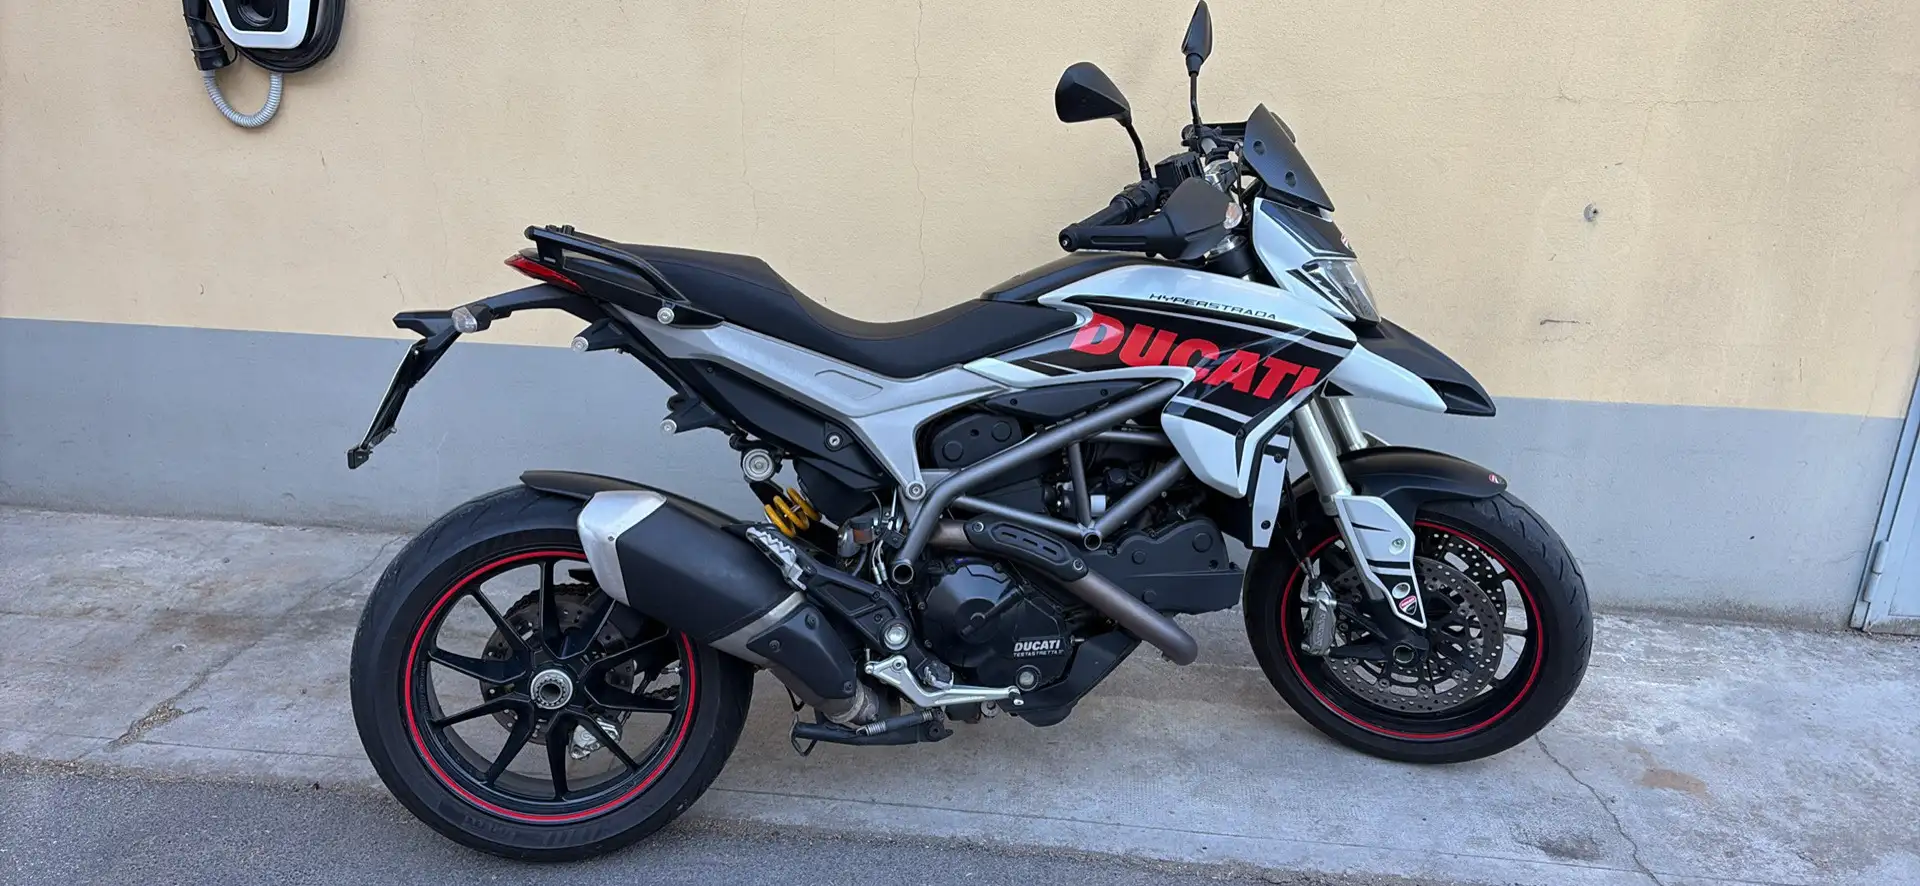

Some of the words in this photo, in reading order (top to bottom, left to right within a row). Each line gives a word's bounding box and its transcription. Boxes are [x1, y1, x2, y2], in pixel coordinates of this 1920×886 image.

[1149, 293, 1276, 320] HYPERSTRADA
[1069, 312, 1320, 399] DUCATI
[1014, 640, 1060, 651] DUCATI
